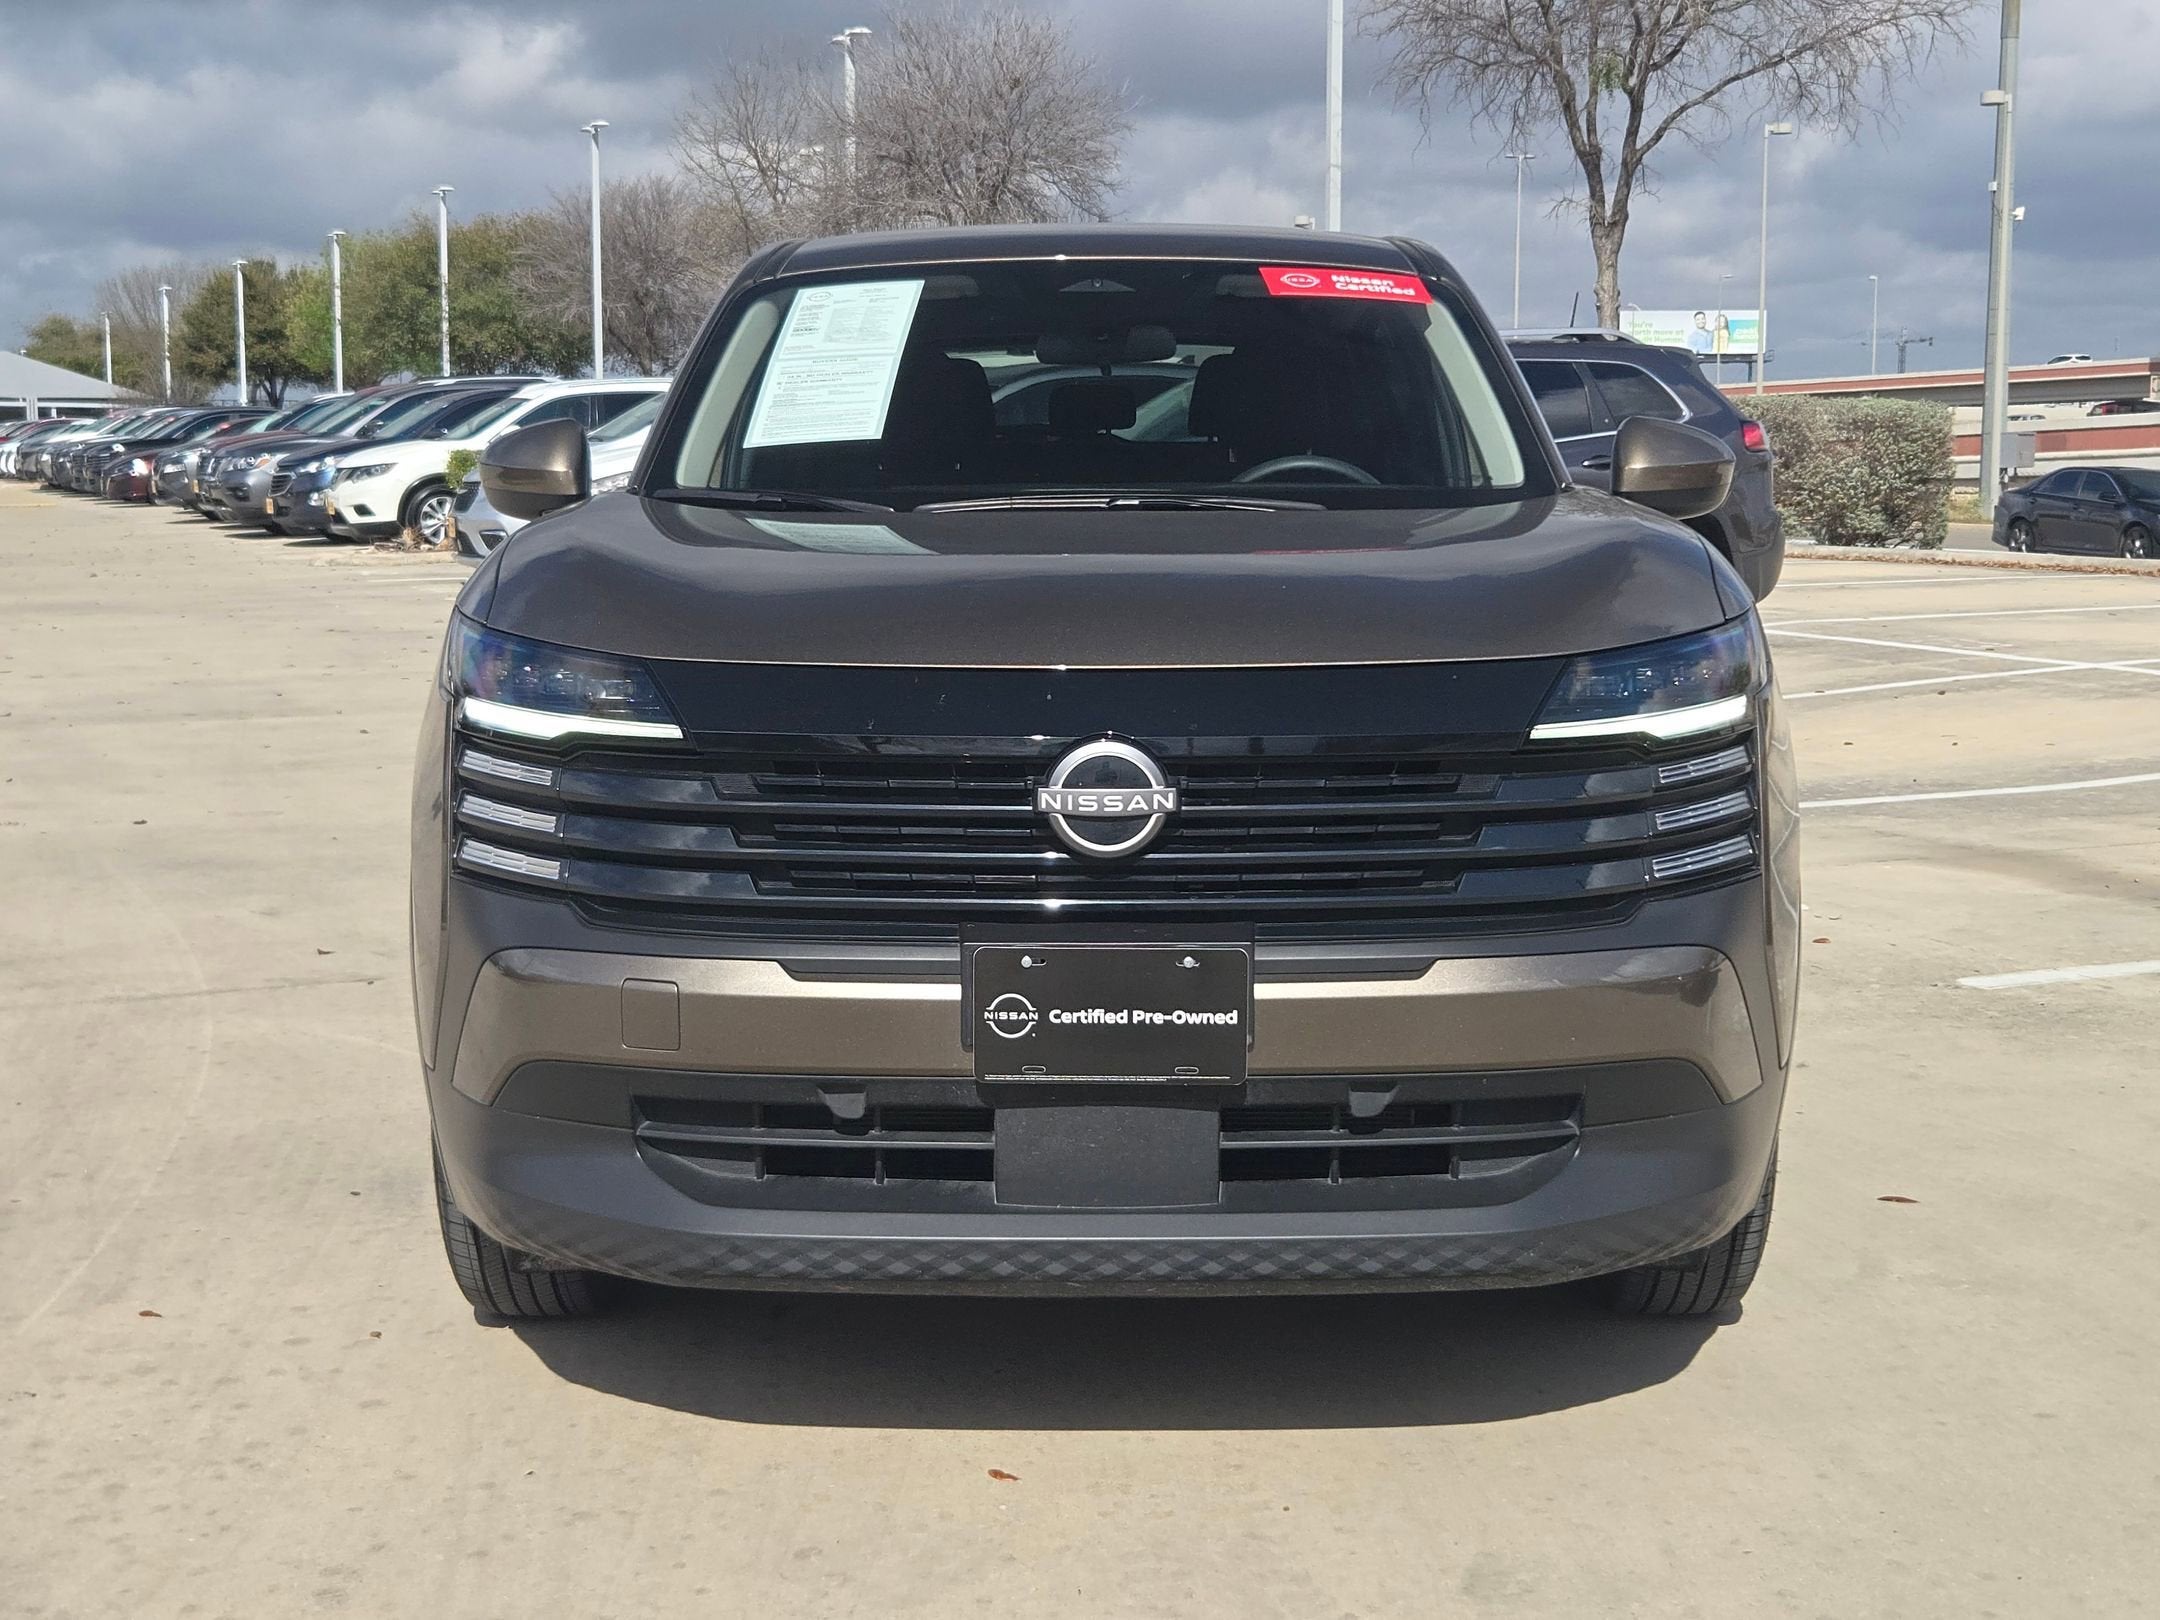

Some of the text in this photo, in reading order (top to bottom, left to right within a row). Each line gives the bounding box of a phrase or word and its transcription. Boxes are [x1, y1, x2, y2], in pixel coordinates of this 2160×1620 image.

[1331, 275, 1394, 286] Nissan
[1335, 283, 1415, 296] Certified
[1040, 791, 1174, 812] NISSAN
[983, 1009, 1238, 1025] NISSAN Certified Pre-Owned
